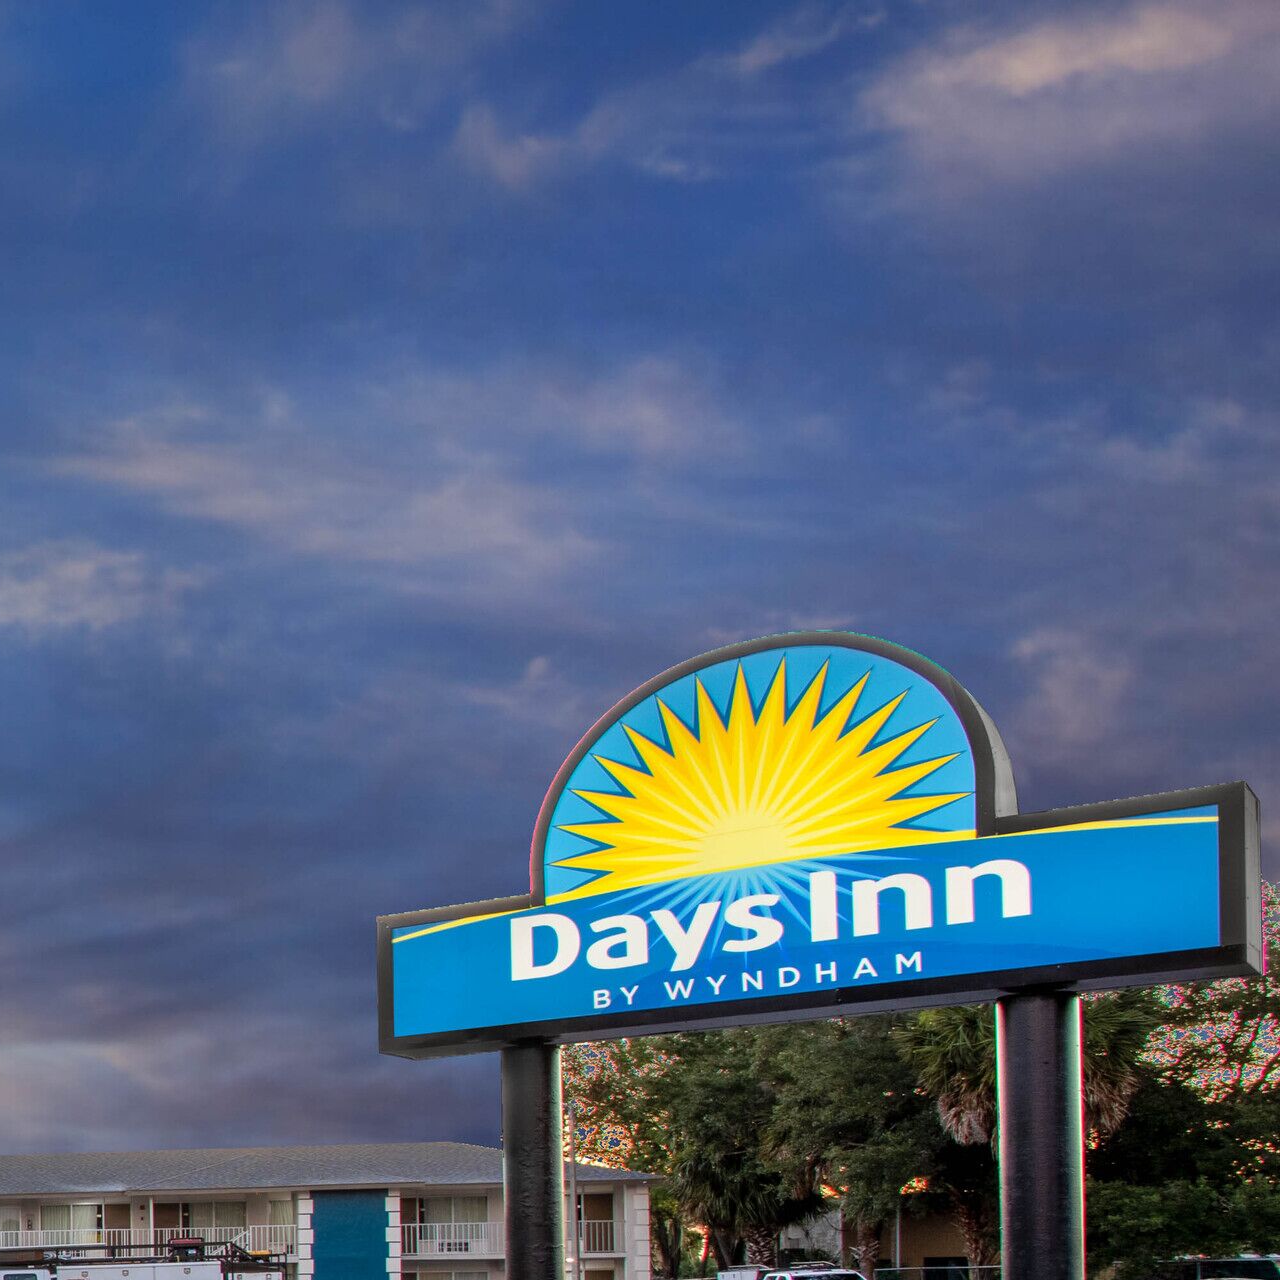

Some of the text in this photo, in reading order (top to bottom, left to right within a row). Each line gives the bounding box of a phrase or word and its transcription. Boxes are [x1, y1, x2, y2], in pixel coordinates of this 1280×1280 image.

[510, 858, 1032, 982] Days Inn
[593, 952, 922, 1009] BY WYNDHAM
